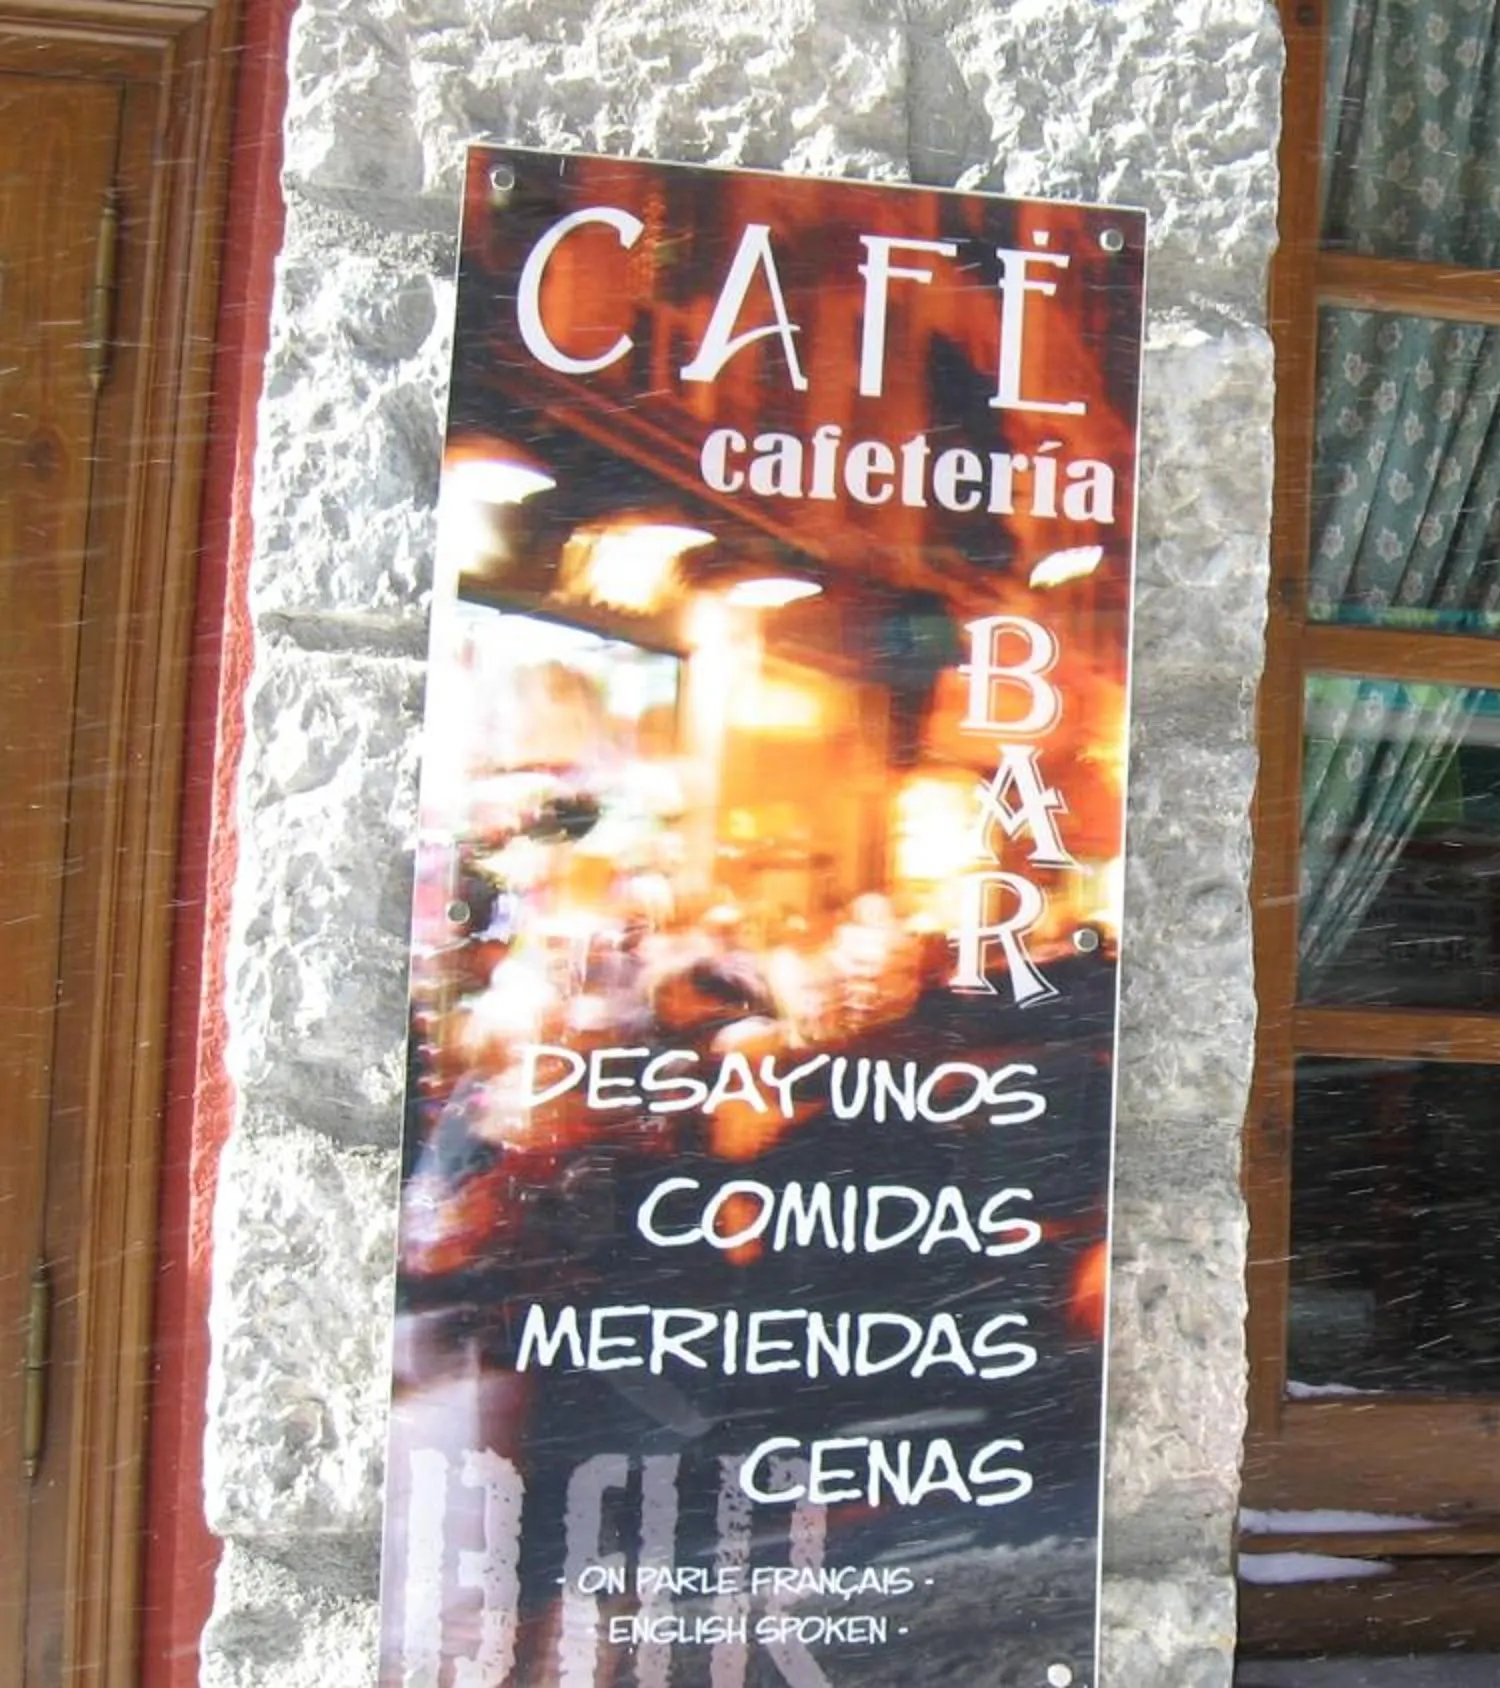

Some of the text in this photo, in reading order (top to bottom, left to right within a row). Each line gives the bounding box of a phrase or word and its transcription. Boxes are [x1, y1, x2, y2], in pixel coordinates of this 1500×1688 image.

[700, 424, 1116, 525] cafetería
[951, 615, 1093, 1009] BAR
[519, 1044, 1047, 1126] DESAYUNOS
[636, 1176, 1043, 1257] COMIDAS
[515, 1303, 1038, 1380] MERIENDAS
[738, 1437, 1035, 1508] CENAS
[577, 1566, 915, 1601] ON PARLE FRANÇAIS
[608, 1616, 889, 1645] ENGLISH SPOKEN
